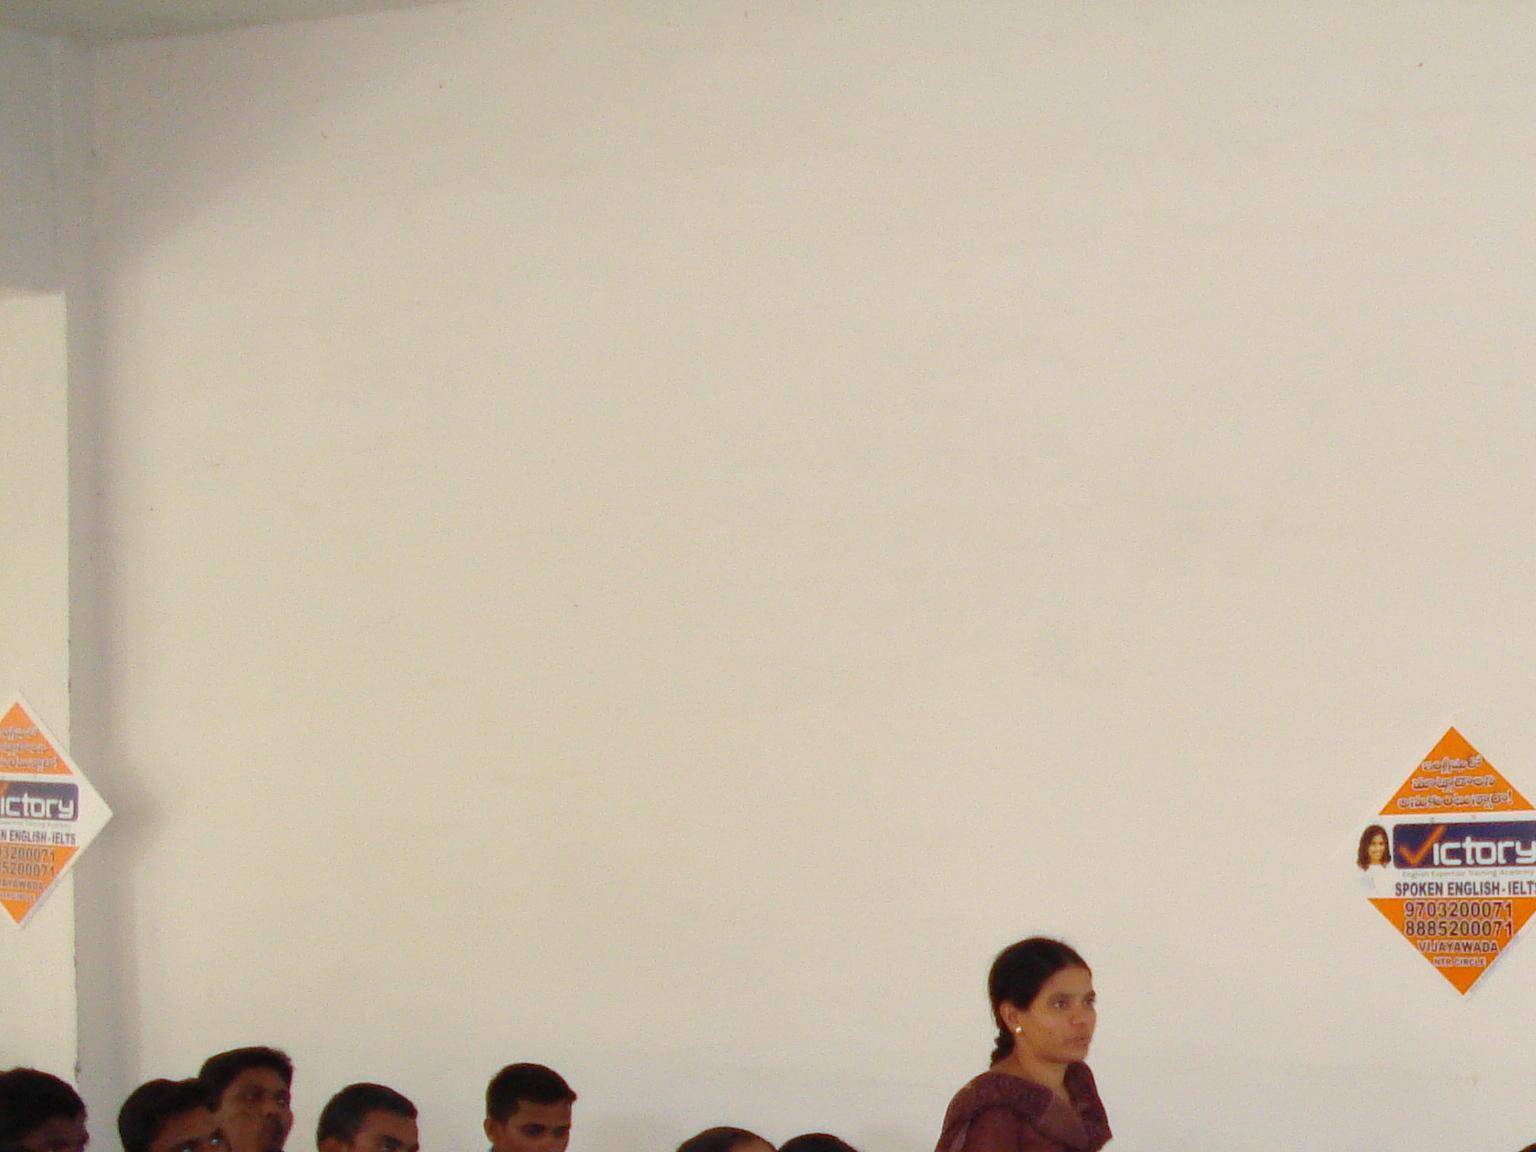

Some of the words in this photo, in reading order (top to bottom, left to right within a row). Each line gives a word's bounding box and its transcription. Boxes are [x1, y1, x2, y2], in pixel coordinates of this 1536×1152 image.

[0, 787, 74, 819] ictory
[1399, 824, 1536, 866] Victory
[1394, 882, 1443, 896] SPOKEN
[1448, 881, 1500, 896] ENGLISH
[1405, 902, 1513, 917] 9703200071
[1405, 921, 1513, 936] 8885200071
[1418, 940, 1498, 953] VIJAYAWADA
